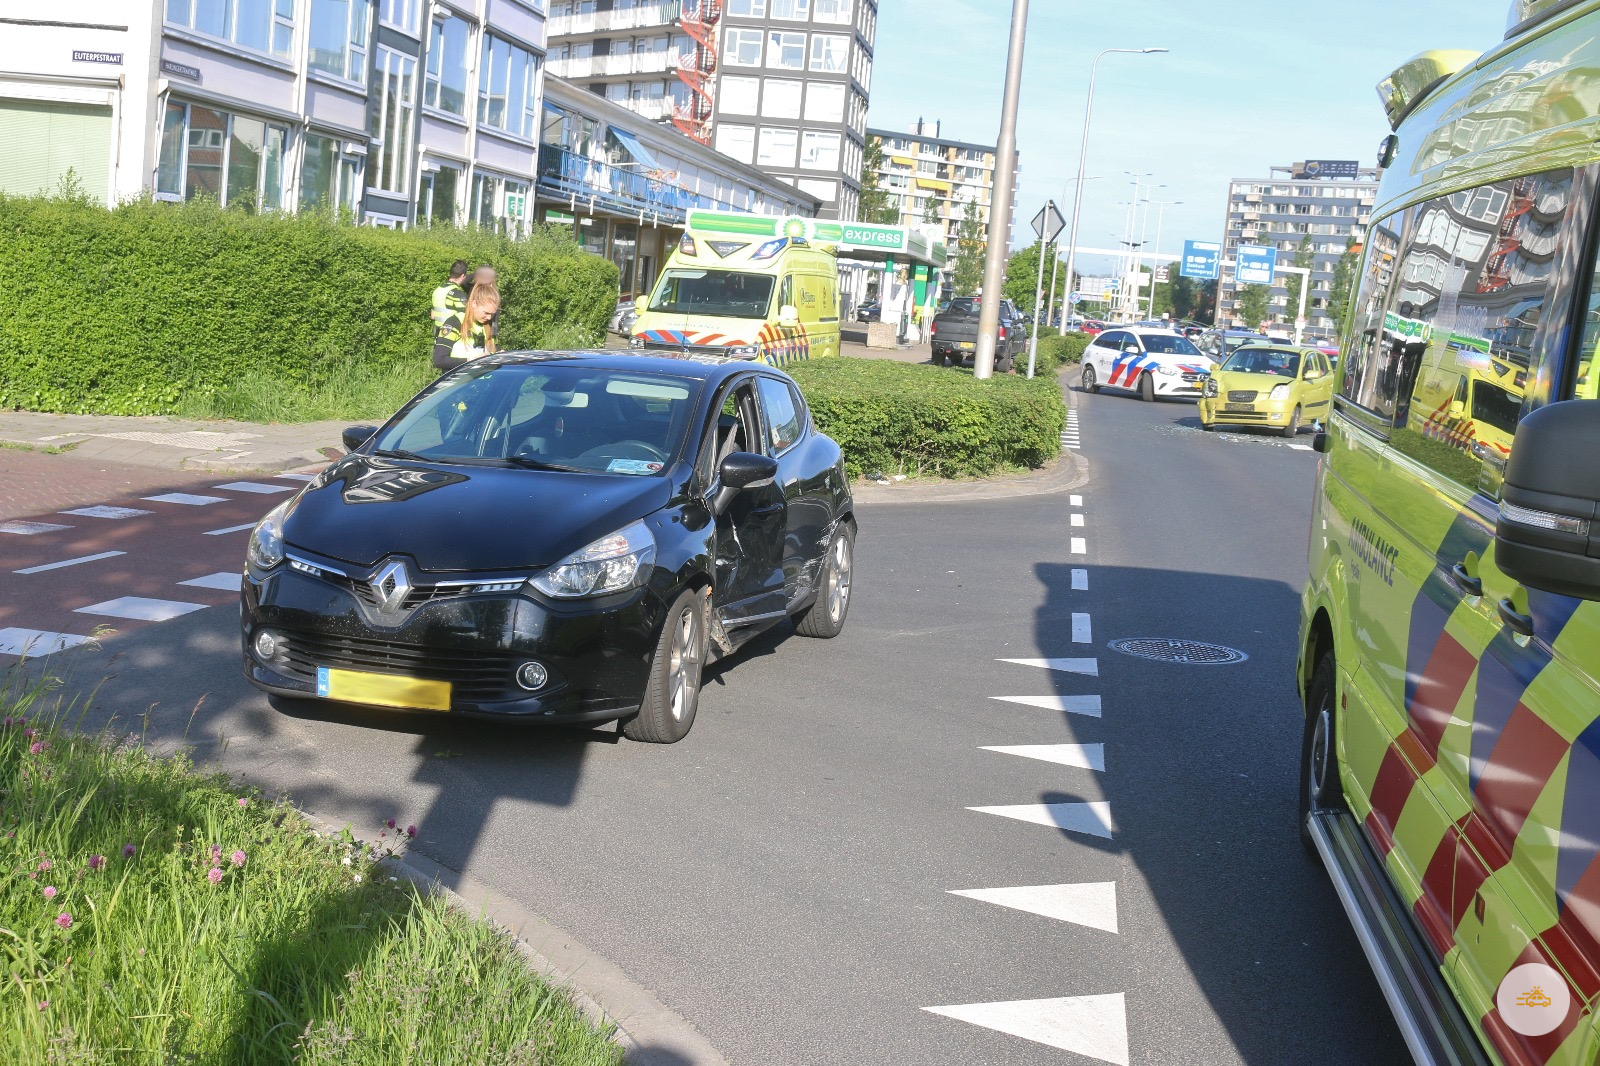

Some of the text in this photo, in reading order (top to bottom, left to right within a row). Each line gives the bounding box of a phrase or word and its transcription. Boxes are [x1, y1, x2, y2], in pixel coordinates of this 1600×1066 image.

[74, 52, 121, 63] EUTERPESTRAAT
[1324, 163, 1357, 174] LEASE
[845, 229, 901, 244] express
[1347, 516, 1399, 588] AMBULANCE
[319, 684, 328, 692] NL
